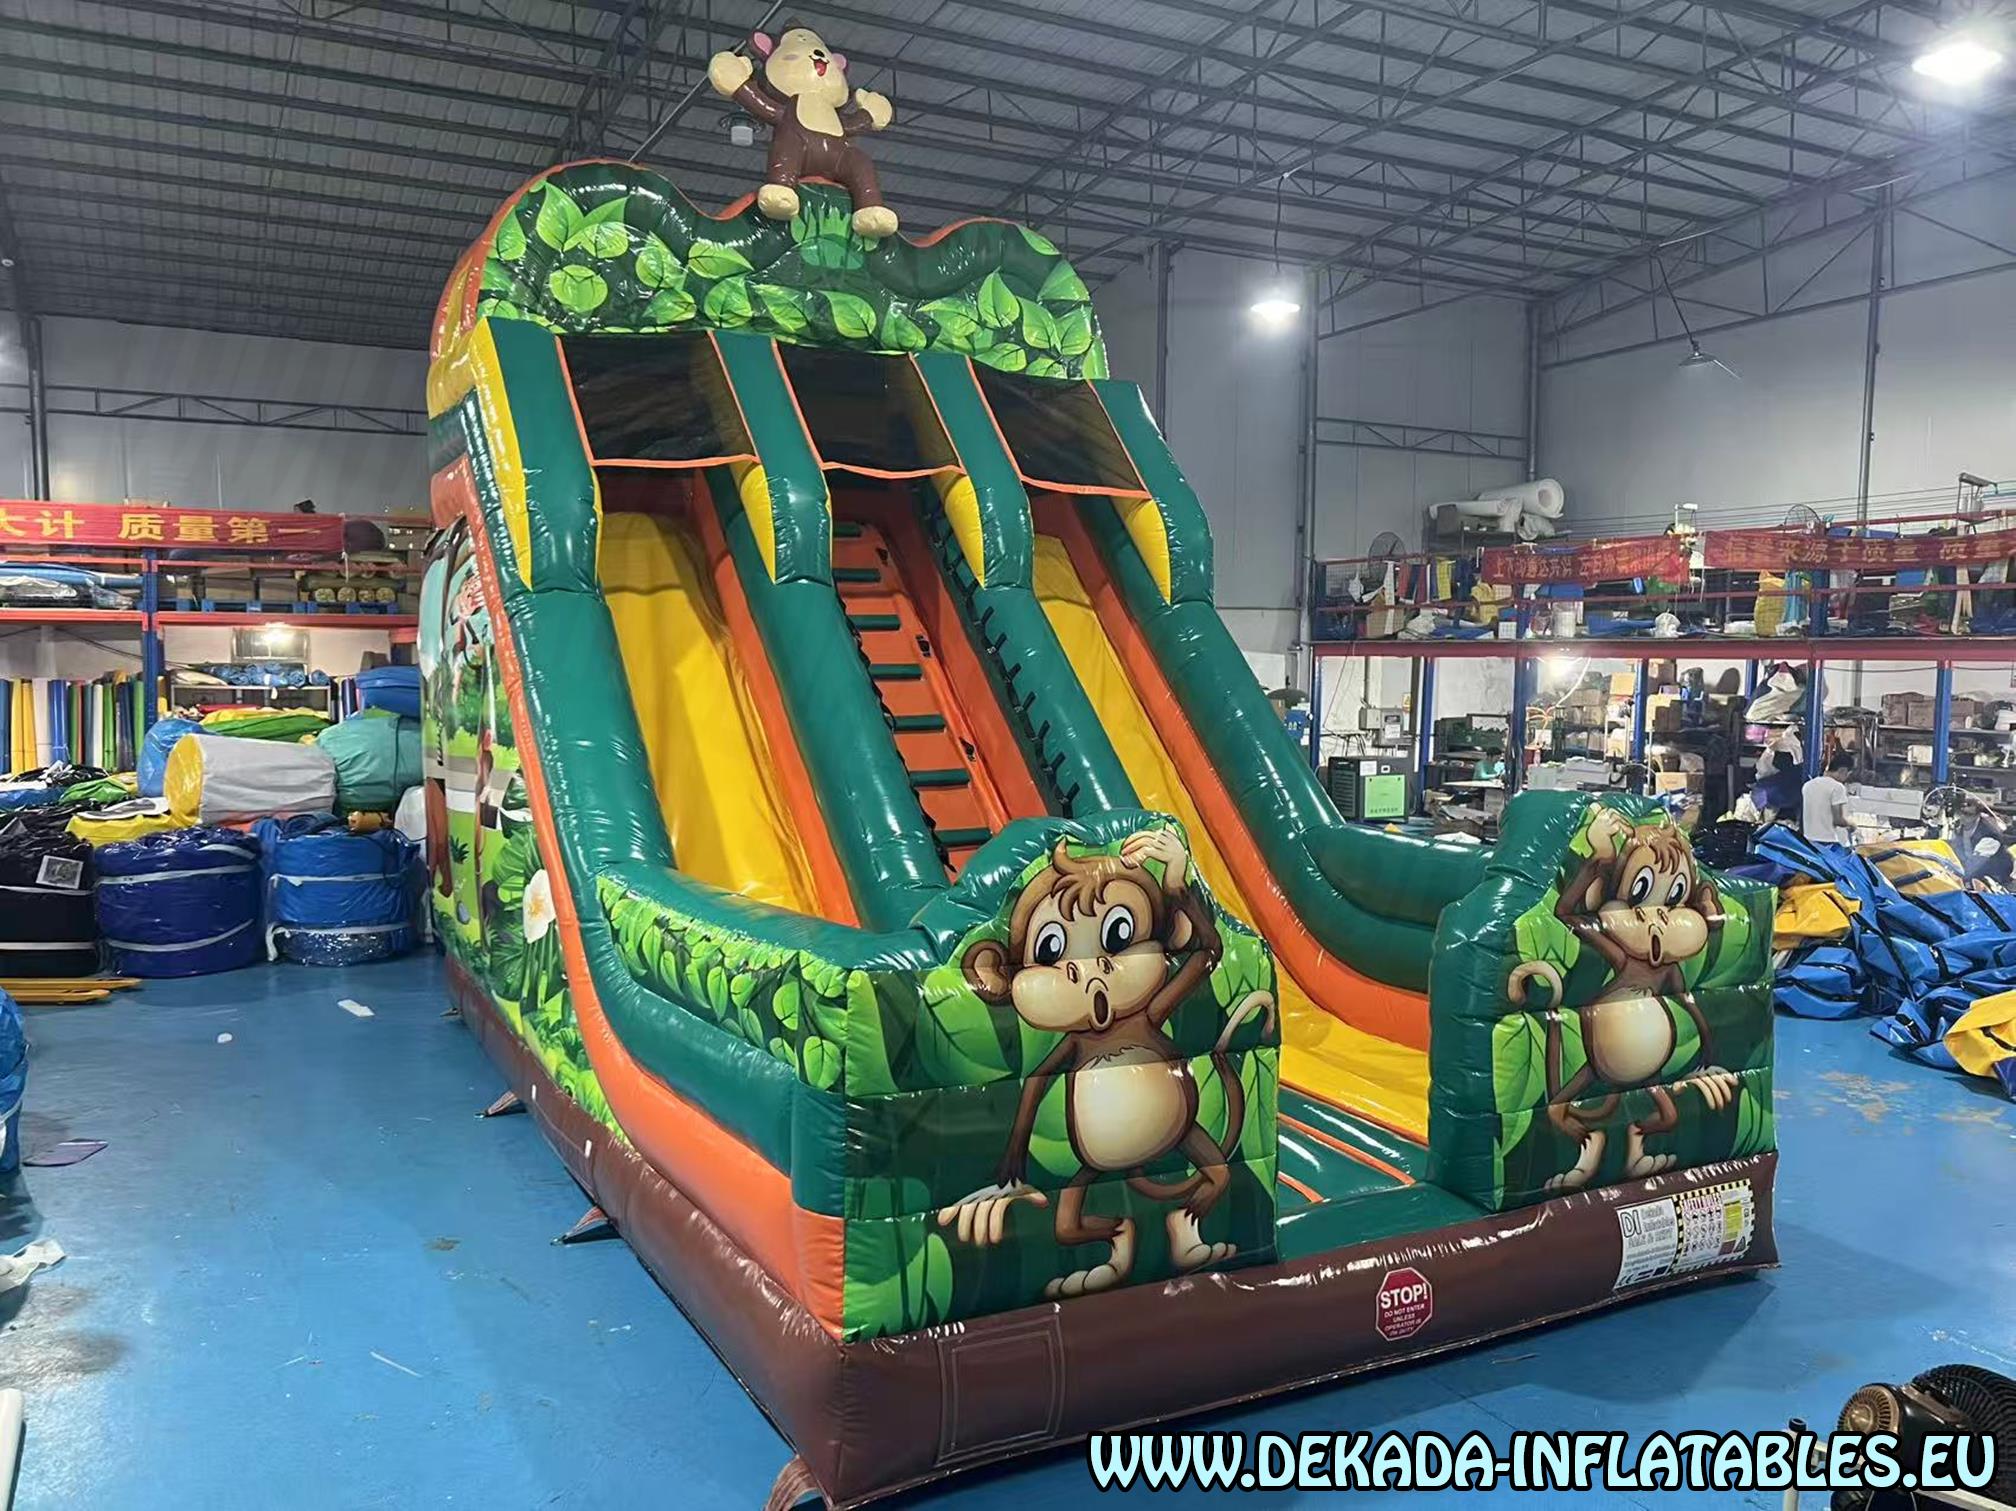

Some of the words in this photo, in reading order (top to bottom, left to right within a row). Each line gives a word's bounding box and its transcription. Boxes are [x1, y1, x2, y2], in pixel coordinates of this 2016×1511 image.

[118, 512, 321, 544] 质量第一
[1620, 1209, 1642, 1238] DI
[1380, 1283, 1428, 1309] STOP!
